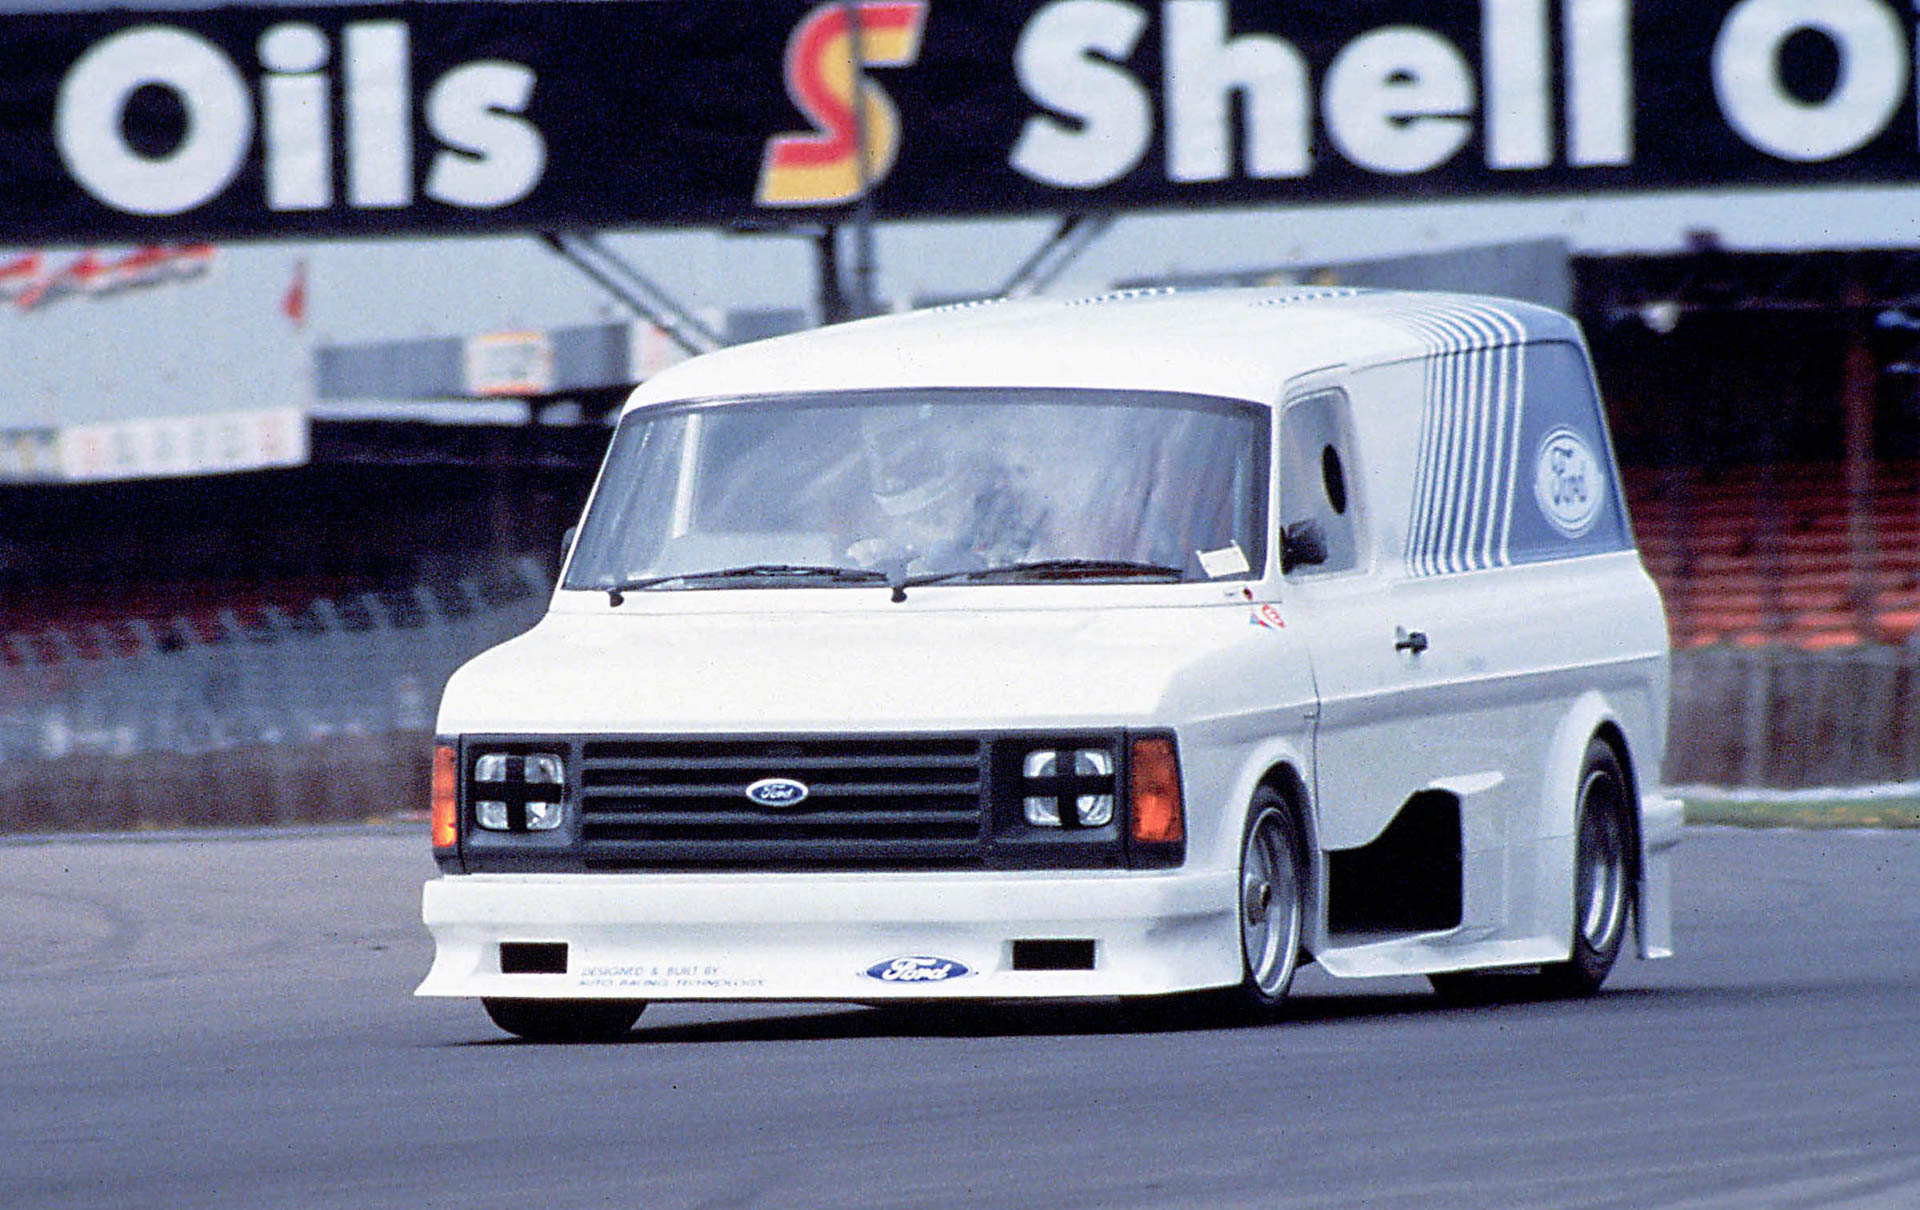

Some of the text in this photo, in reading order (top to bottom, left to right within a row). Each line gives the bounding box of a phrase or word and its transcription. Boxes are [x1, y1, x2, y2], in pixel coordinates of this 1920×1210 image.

[53, 20, 547, 217] Oils
[1009, 0, 1636, 190] Shell
[1711, 0, 1920, 163] O
[760, 783, 794, 799] Ford
[667, 966, 697, 976] BUILT
[704, 966, 719, 976] BY
[882, 957, 952, 981] Ford
